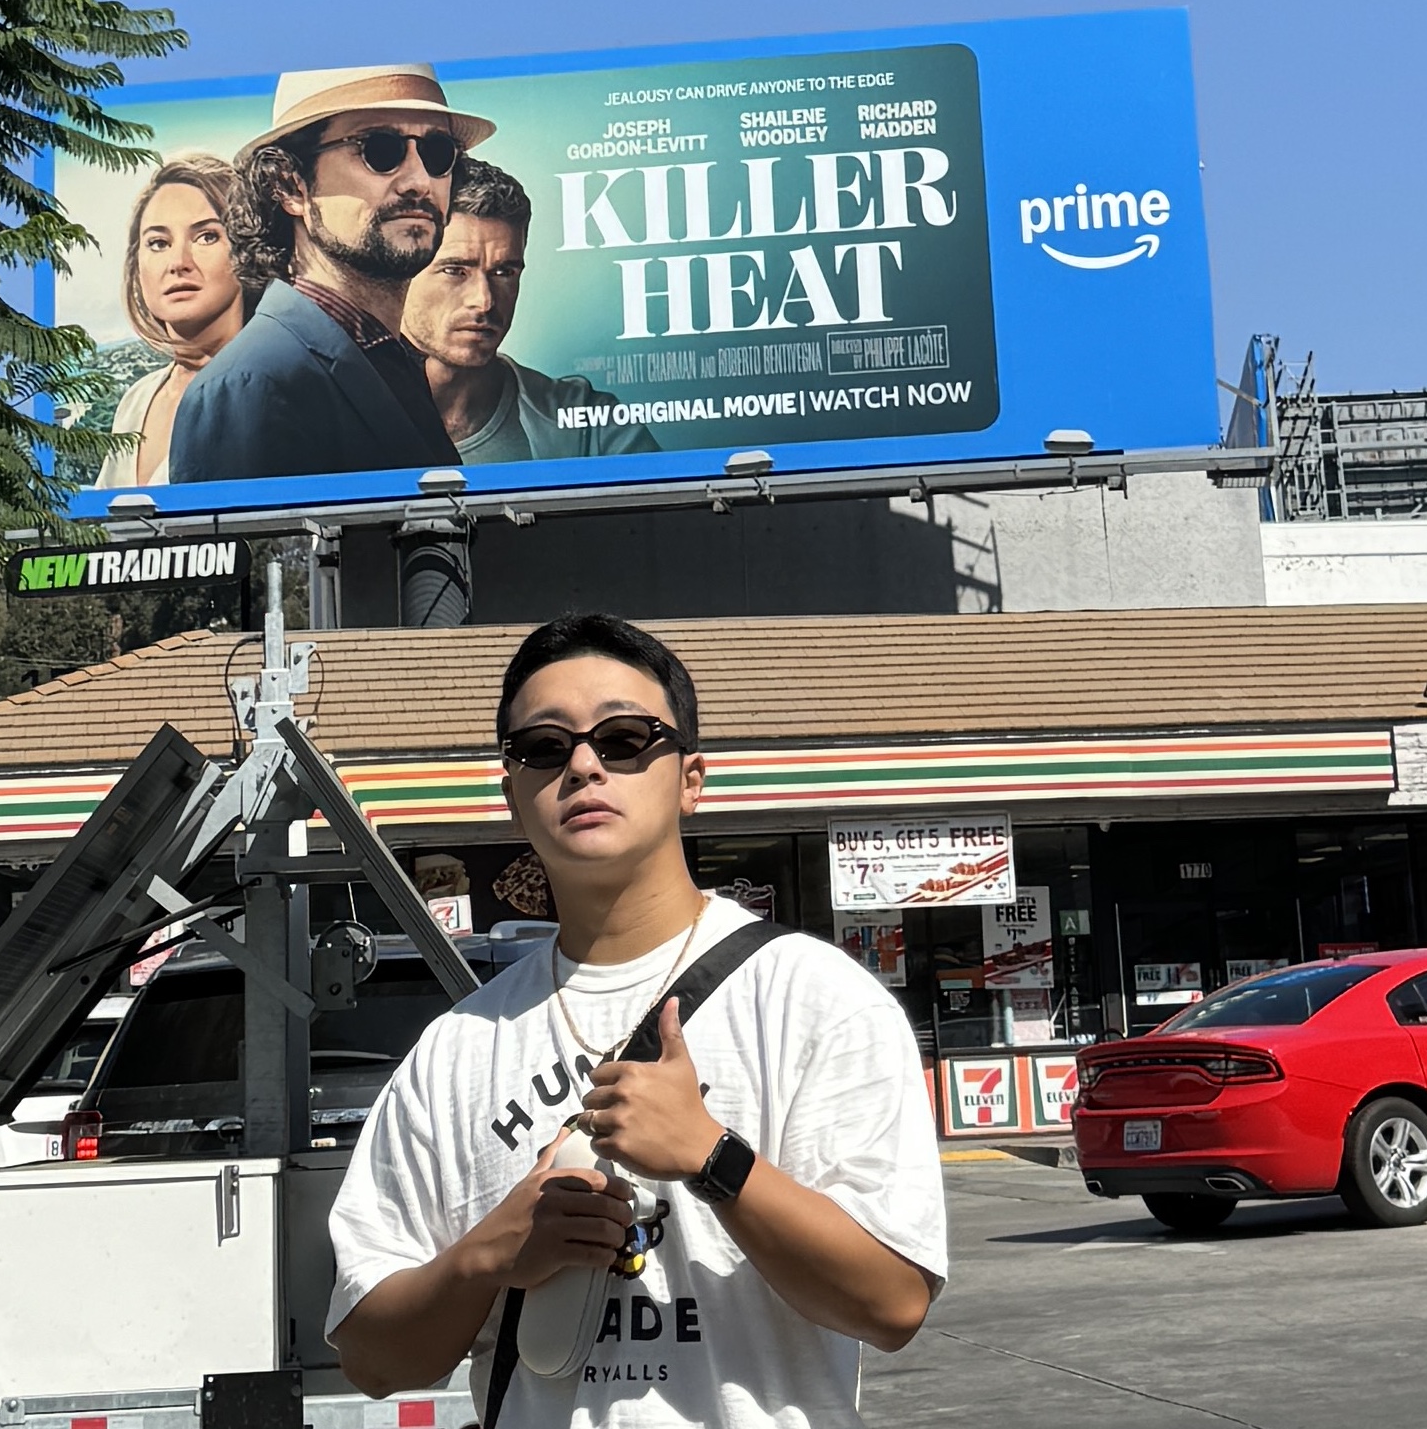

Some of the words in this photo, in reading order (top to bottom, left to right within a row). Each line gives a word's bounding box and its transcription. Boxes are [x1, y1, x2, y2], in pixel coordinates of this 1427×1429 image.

[604, 88, 673, 107] JEALOUSY
[676, 86, 704, 101] CAN
[706, 82, 747, 98] DRIVE
[749, 78, 805, 95] ANYONE
[807, 76, 825, 91] TO
[828, 75, 855, 89] THE
[858, 72, 895, 88] EDGE
[740, 107, 826, 129] SHAILENE
[858, 99, 937, 121] RICHARD
[602, 118, 671, 139] JOSEPH
[740, 126, 828, 148] WOODLEY
[860, 119, 937, 140] MADDEN
[567, 134, 708, 160] GORDON-LEVITT
[554, 147, 957, 252] KILLER
[1020, 183, 1171, 244] prime
[612, 241, 903, 339] HEAT
[864, 336, 905, 369] PHILIPPE
[908, 329, 945, 366] LACÔTE
[617, 354, 644, 384] MATT
[700, 356, 716, 379] AND
[718, 345, 760, 378] ROBERTO
[762, 342, 823, 374] BENTIVEGNA
[557, 405, 610, 429] NEW
[612, 397, 722, 426] ORIGINAL
[724, 392, 797, 419] MOVIE
[809, 385, 900, 412] WATCH
[908, 380, 972, 407] NOW
[836, 830, 869, 852] BUY
[873, 830, 890, 853] 5,
[896, 829, 925, 850] GET
[928, 828, 940, 849] 5
[949, 826, 1005, 848] FREE
[1180, 863, 1212, 879] 1770
[995, 904, 1038, 922] FREE
[1064, 917, 1077, 930] A
[963, 1067, 1002, 1123] 7
[595, 1296, 702, 1343] ADE
